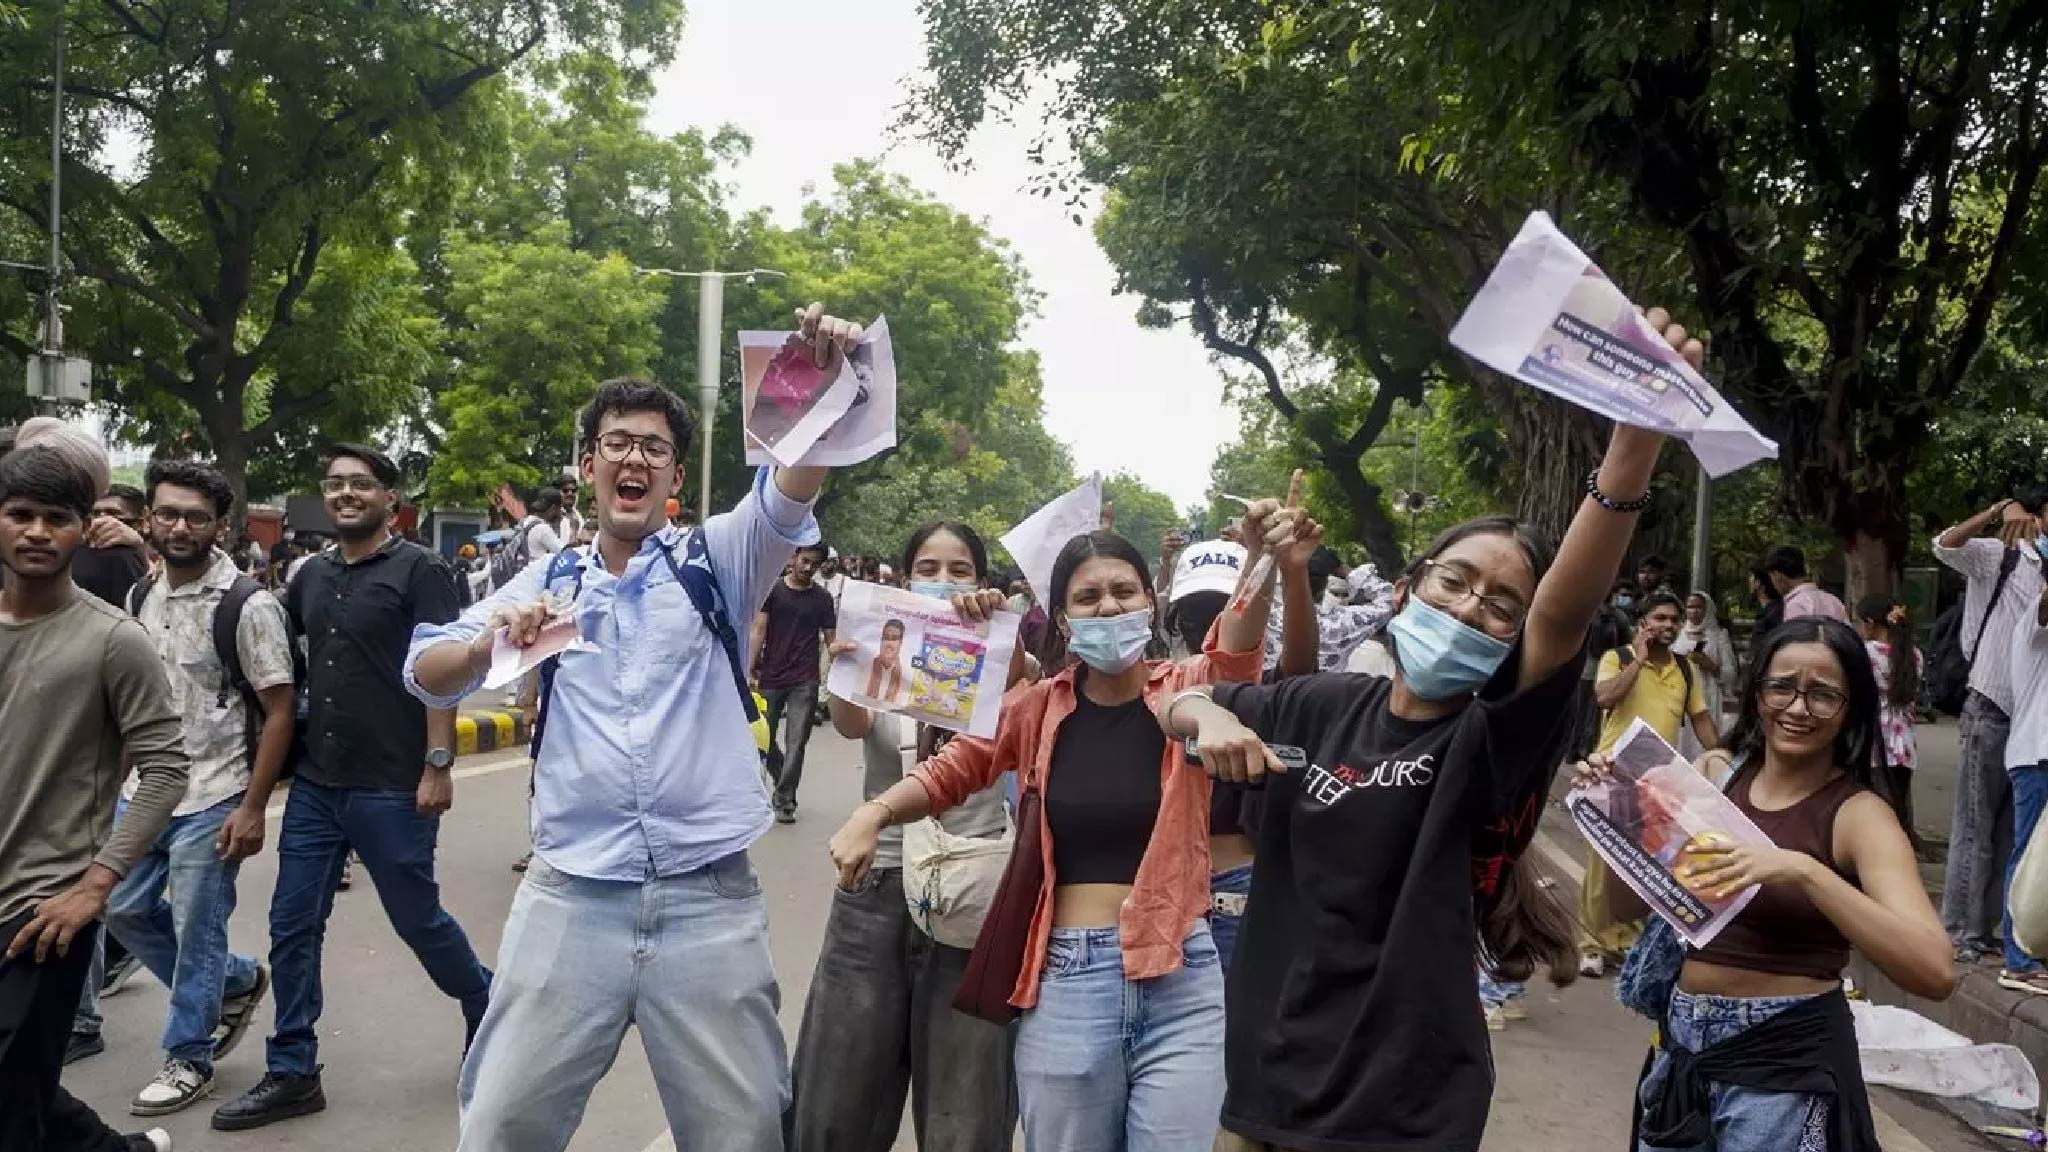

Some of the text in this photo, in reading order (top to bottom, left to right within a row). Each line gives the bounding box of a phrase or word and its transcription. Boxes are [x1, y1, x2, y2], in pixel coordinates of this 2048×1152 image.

[1583, 330, 1604, 347] can
[1604, 342, 1654, 372] someone
[1592, 350, 1637, 380] this guy
[1188, 552, 1239, 571] YALE
[1354, 753, 1434, 788] OURS
[1605, 828, 1639, 857] protest
